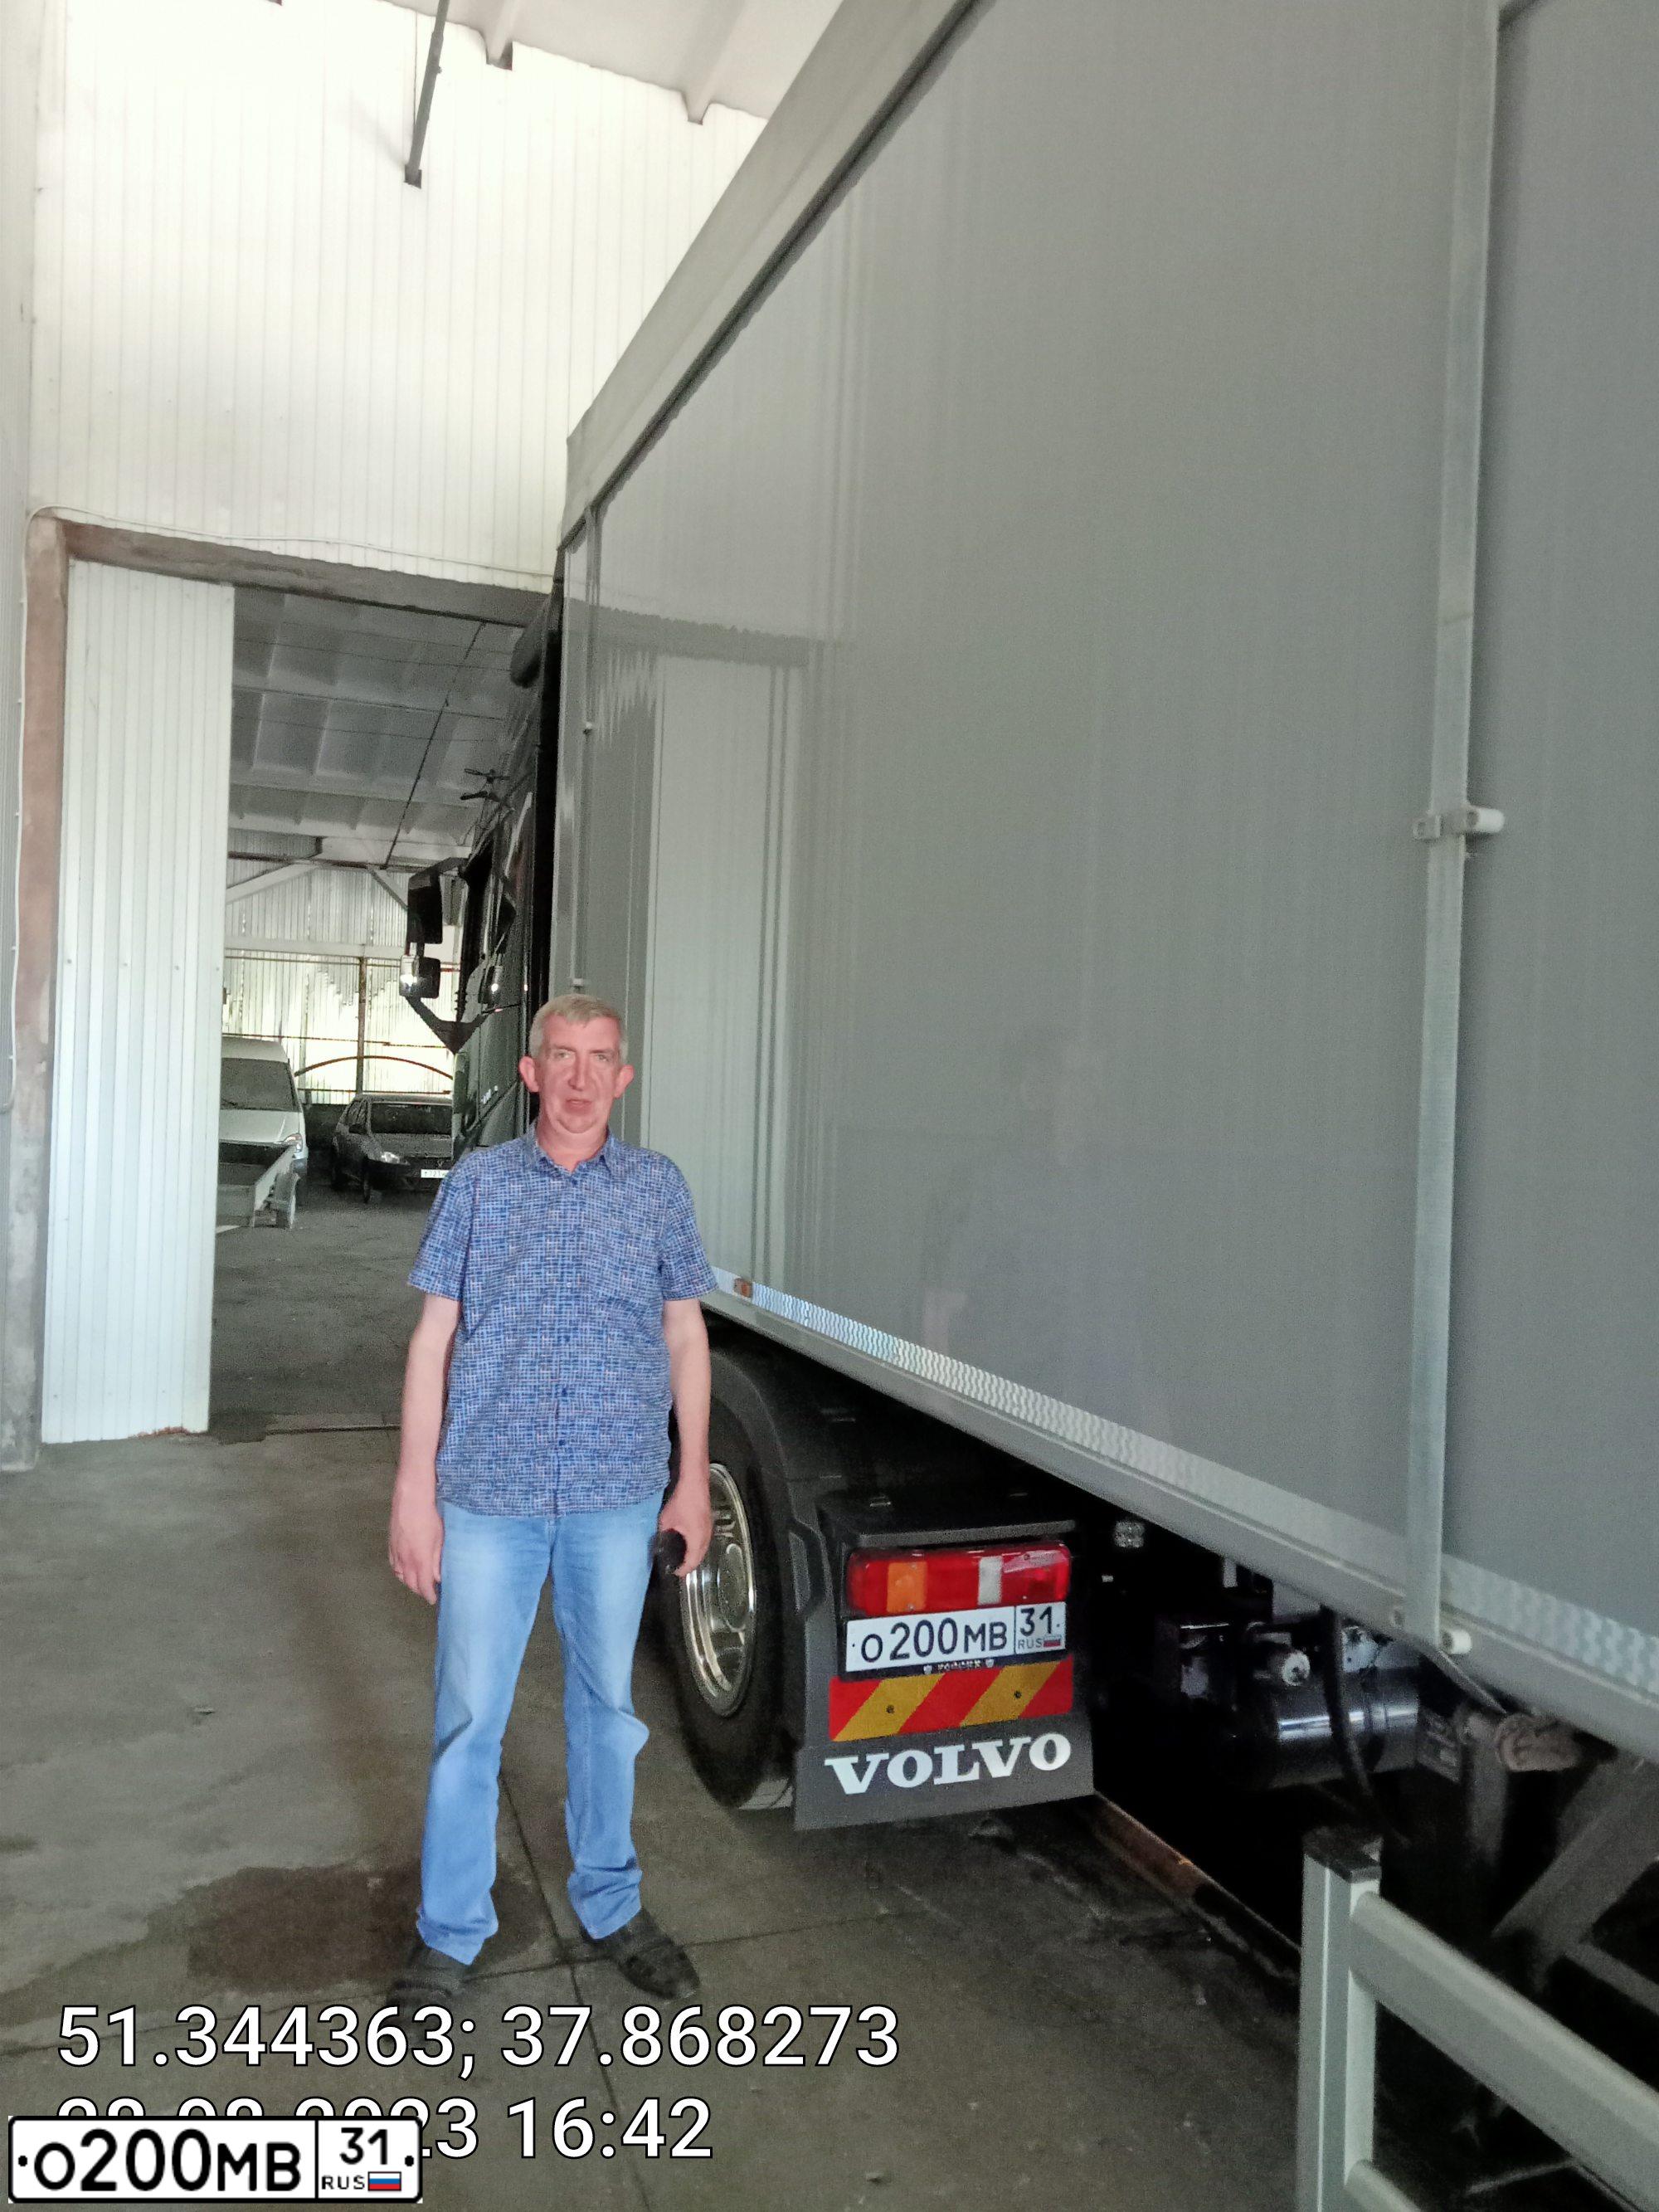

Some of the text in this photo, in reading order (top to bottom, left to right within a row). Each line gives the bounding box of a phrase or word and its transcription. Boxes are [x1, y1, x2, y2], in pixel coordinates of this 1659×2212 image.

[860, 1606, 1053, 1663] О200МВ 31
[1018, 1640, 1043, 1649] RUS
[825, 1732, 1072, 1795] VOLVO
